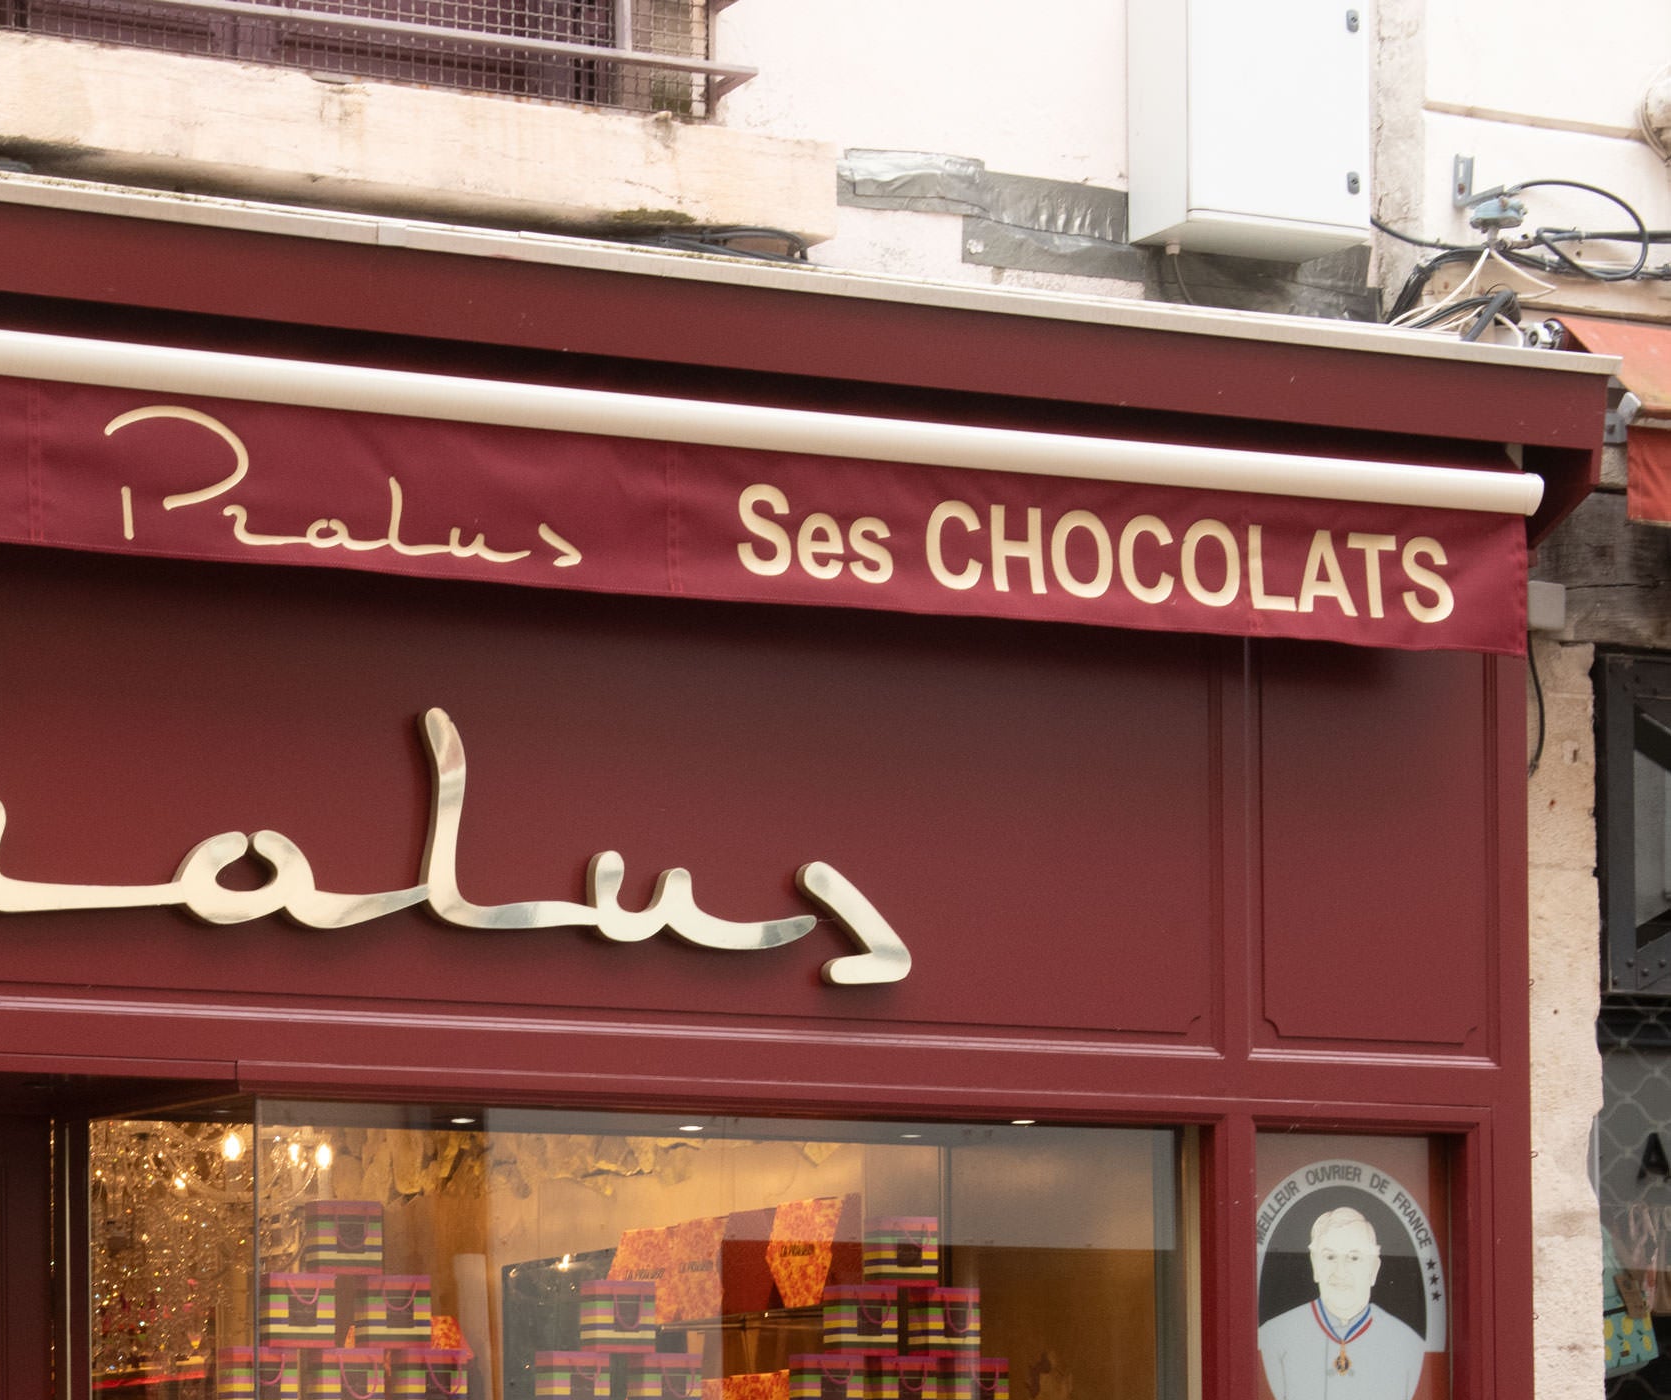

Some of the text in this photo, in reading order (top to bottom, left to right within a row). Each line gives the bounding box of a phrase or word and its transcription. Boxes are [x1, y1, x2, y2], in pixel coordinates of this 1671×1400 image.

[104, 405, 582, 567] Pralus
[737, 483, 1455, 623] Ses CHOCOLATS
[1257, 1164, 1433, 1249] MEILLEUR OUVRIER DE FRANCE
